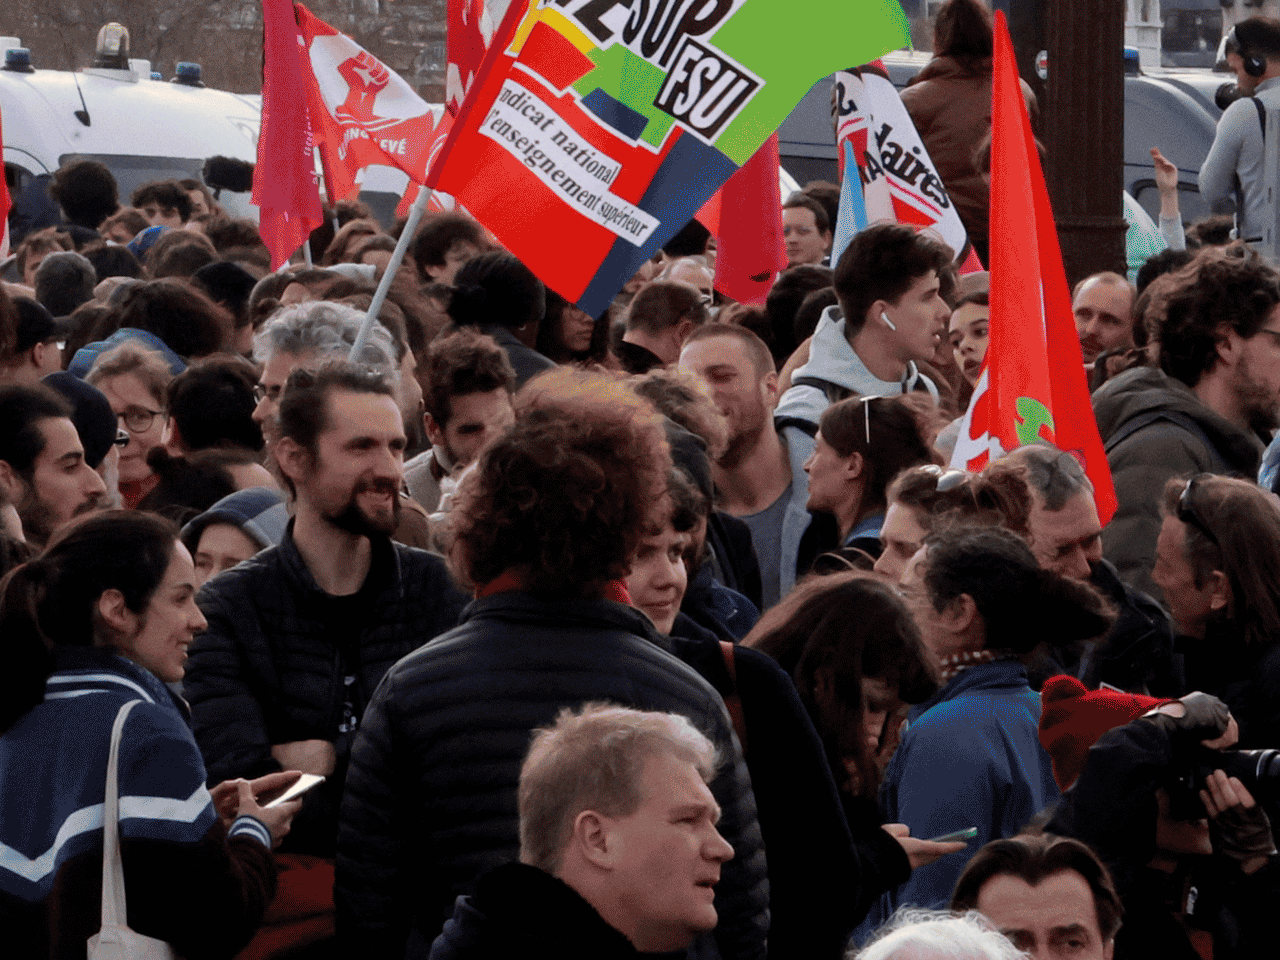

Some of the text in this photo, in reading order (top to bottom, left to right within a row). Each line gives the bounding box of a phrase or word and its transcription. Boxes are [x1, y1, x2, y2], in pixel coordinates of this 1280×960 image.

[657, 43, 749, 128] FSU
[551, 130, 619, 185] national
[598, 201, 649, 238] supérieur
